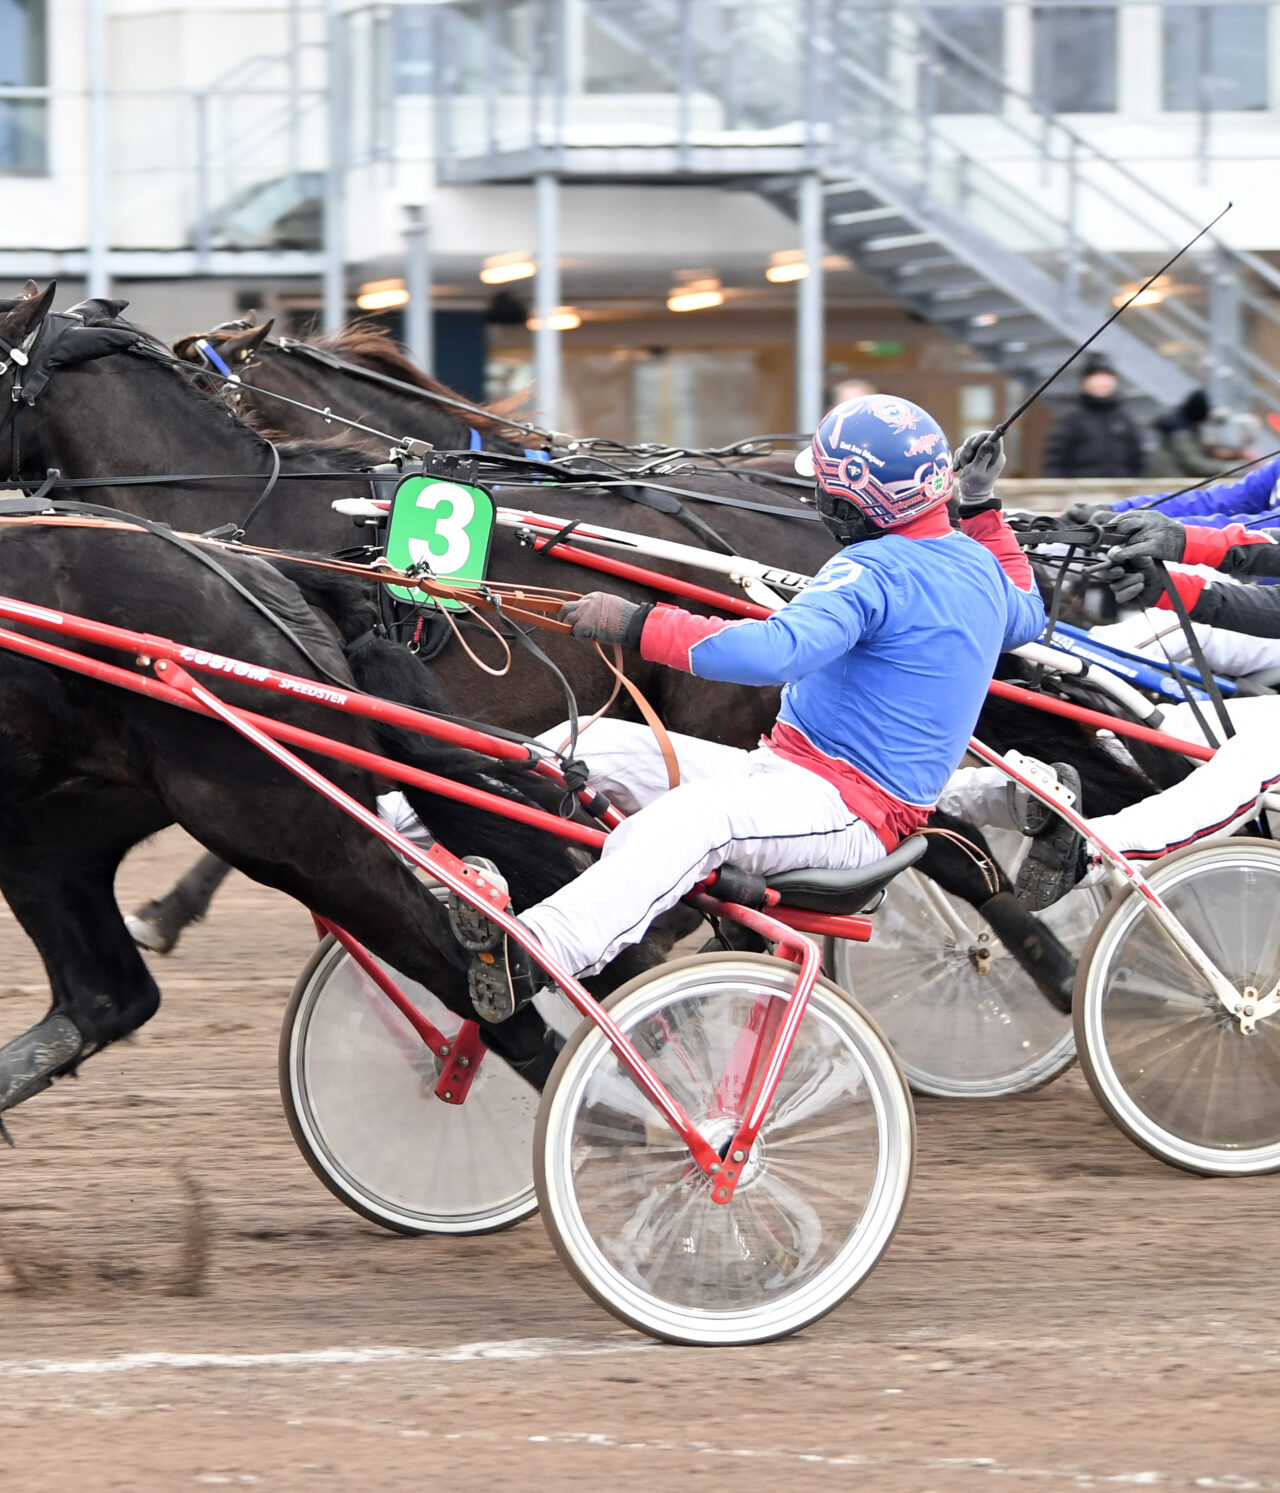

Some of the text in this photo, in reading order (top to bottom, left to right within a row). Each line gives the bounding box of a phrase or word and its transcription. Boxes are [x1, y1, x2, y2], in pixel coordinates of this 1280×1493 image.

[408, 483, 475, 574] 3
[179, 647, 348, 705] CUSTOM SPEEDSTER
